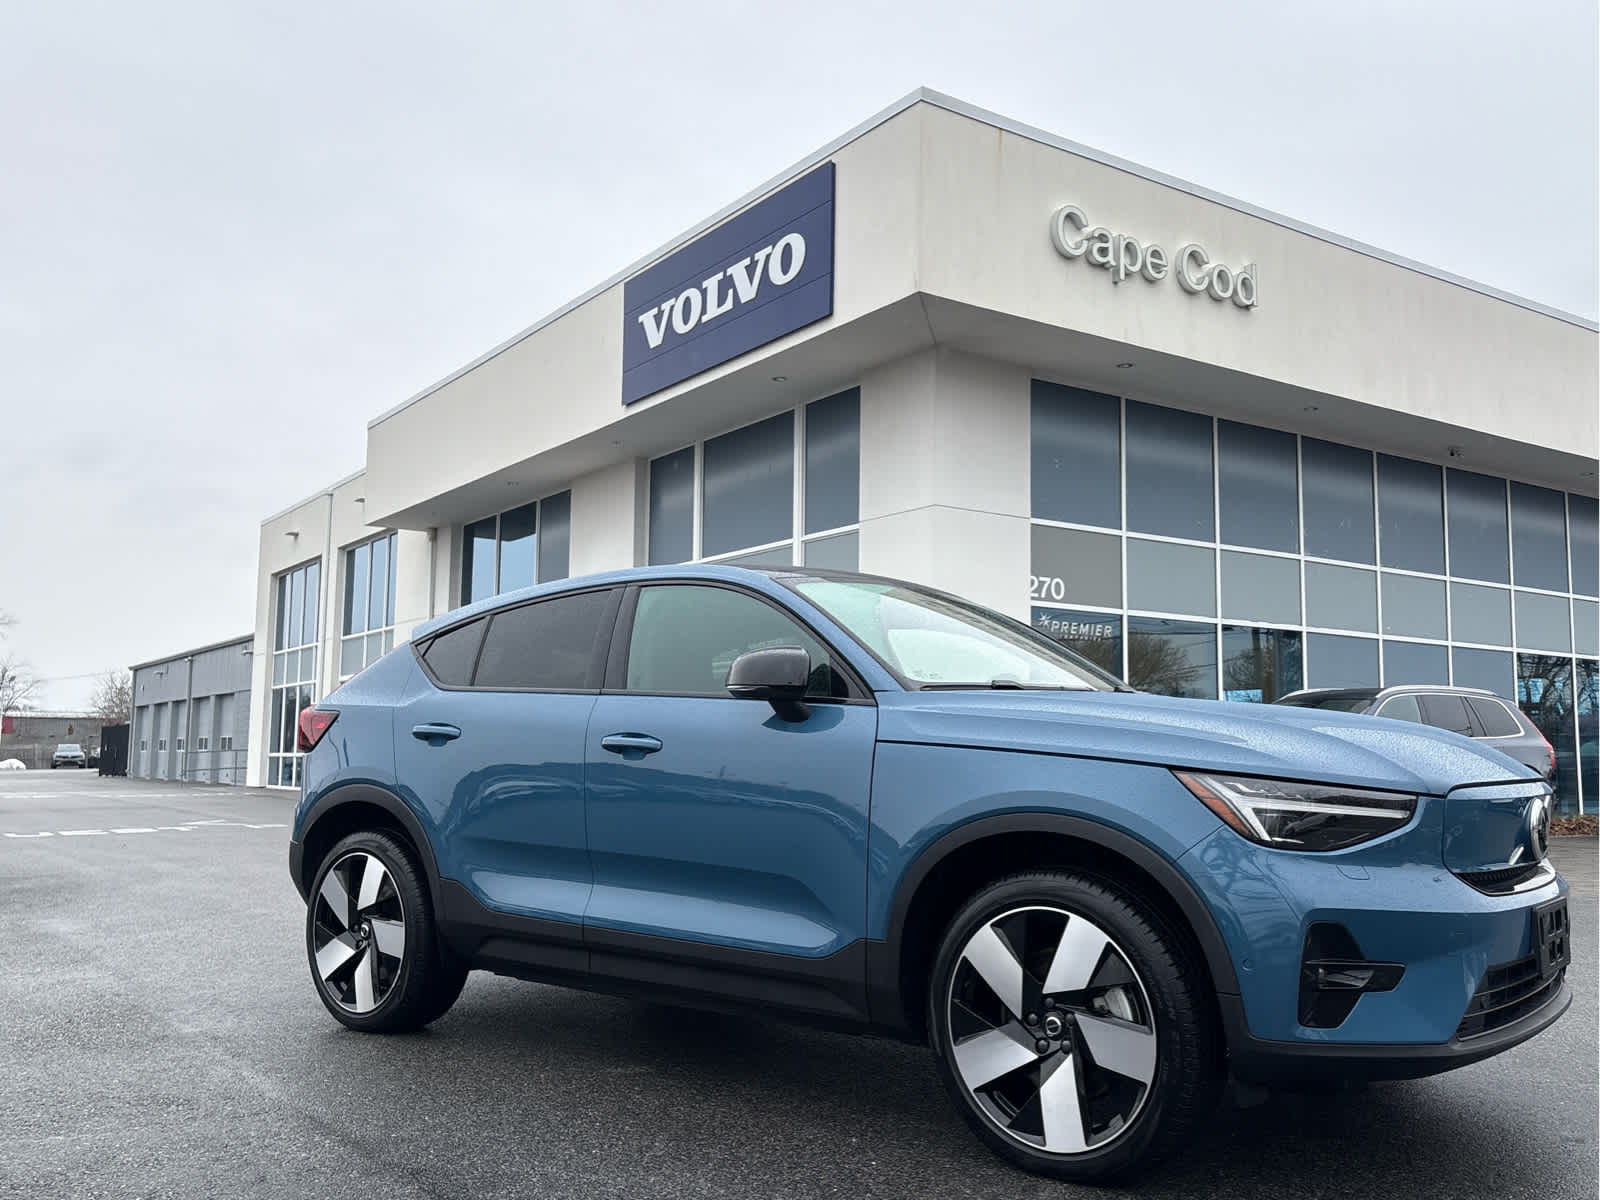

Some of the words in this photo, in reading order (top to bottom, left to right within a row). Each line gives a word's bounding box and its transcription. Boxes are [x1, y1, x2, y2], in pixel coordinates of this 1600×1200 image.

[1051, 204, 1168, 283] Cape
[1175, 243, 1258, 309] Cod
[638, 232, 806, 349] VOLVO
[1030, 575, 1065, 600] 270
[1051, 620, 1113, 638] PREMIER
